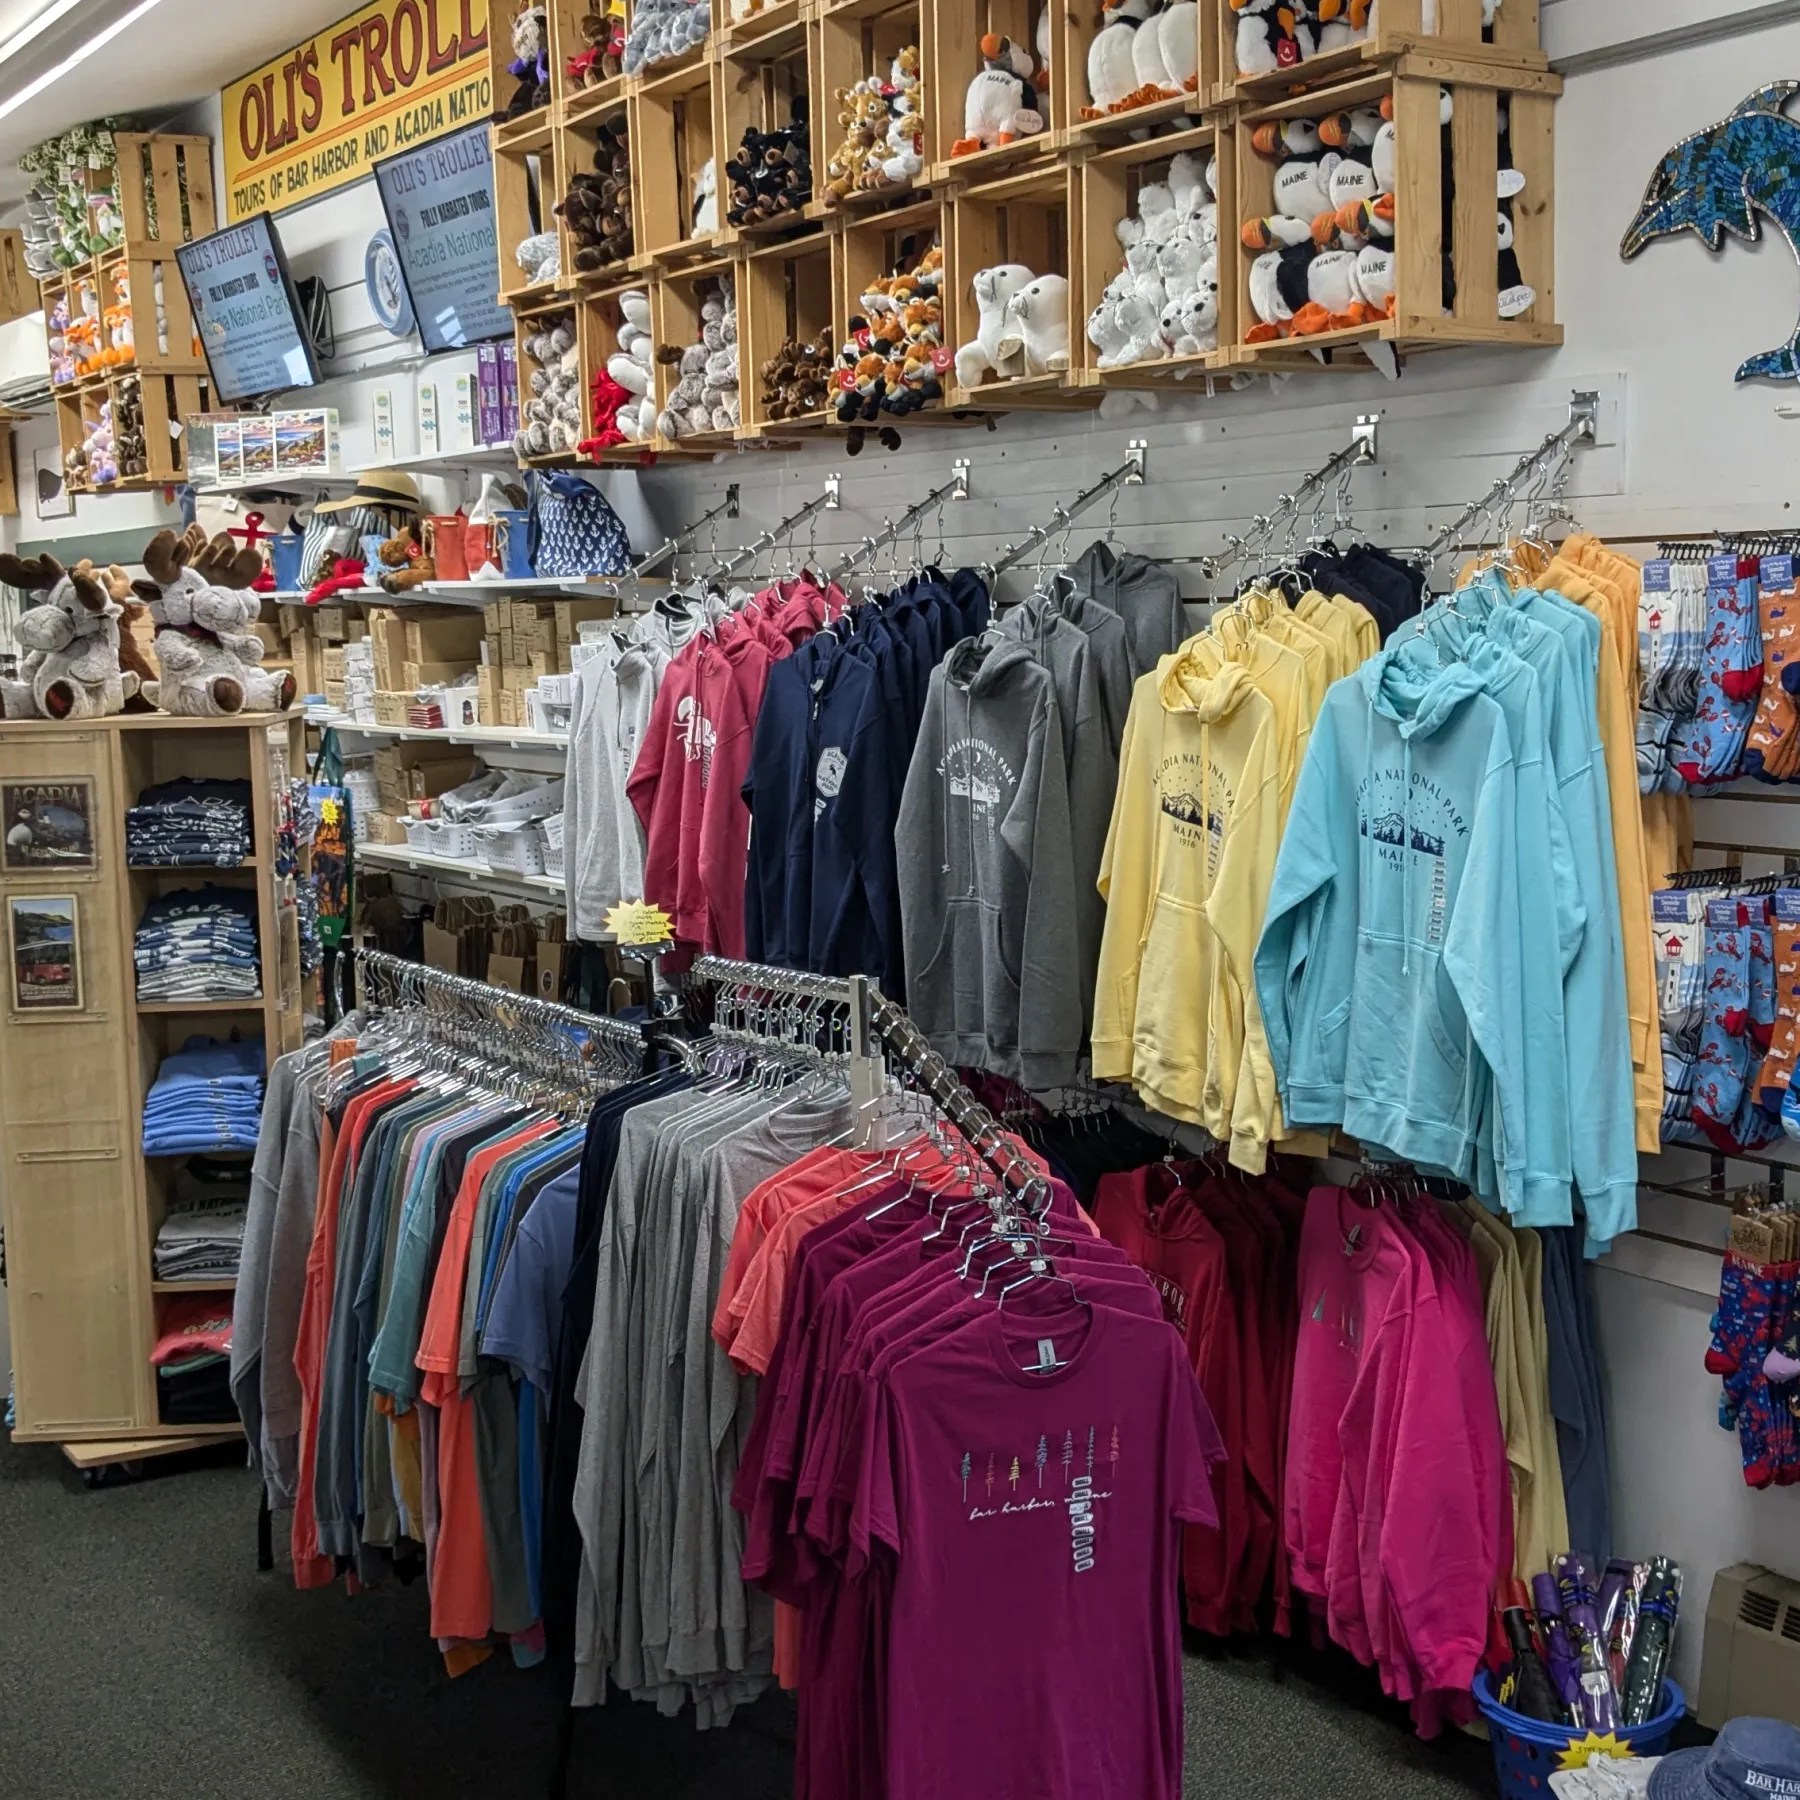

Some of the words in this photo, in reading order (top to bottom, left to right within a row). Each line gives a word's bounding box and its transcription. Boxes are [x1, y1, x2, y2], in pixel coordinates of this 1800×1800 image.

[240, 41, 323, 161] OLI'S
[331, 0, 489, 115] TROLL
[234, 180, 266, 215] TOURS
[270, 171, 284, 200] OF
[287, 163, 309, 193] BAR
[312, 138, 359, 182] HARBOR
[364, 124, 389, 159] AND
[394, 98, 444, 147] ACADIA
[449, 76, 491, 121] NATIO
[391, 160, 427, 195] OLI'S
[427, 131, 493, 182] TROLLEY
[1281, 171, 1309, 188] MAINE
[1336, 174, 1364, 187] MAINE
[420, 205, 439, 229] FULLY
[437, 196, 470, 223] NARRATED
[467, 189, 491, 214] TOURS
[186, 245, 213, 275] OLI'S
[211, 225, 259, 265] TROLLEY
[408, 240, 447, 270] Acadia
[448, 217, 497, 258] National
[1361, 261, 1387, 275] MAINE
[230, 298, 266, 329] National
[998, 757, 1017, 786] PARK
[1152, 755, 1179, 788] ACDIA
[13, 786, 82, 811] ACADIA
[973, 803, 987, 814] INE
[1386, 769, 1443, 800] NATONAL
[1443, 799, 1470, 838] PARK
[1378, 848, 1418, 867] MAIE
[970, 1507, 998, 1520] bar
[1744, 1769, 1772, 1788] BAR
